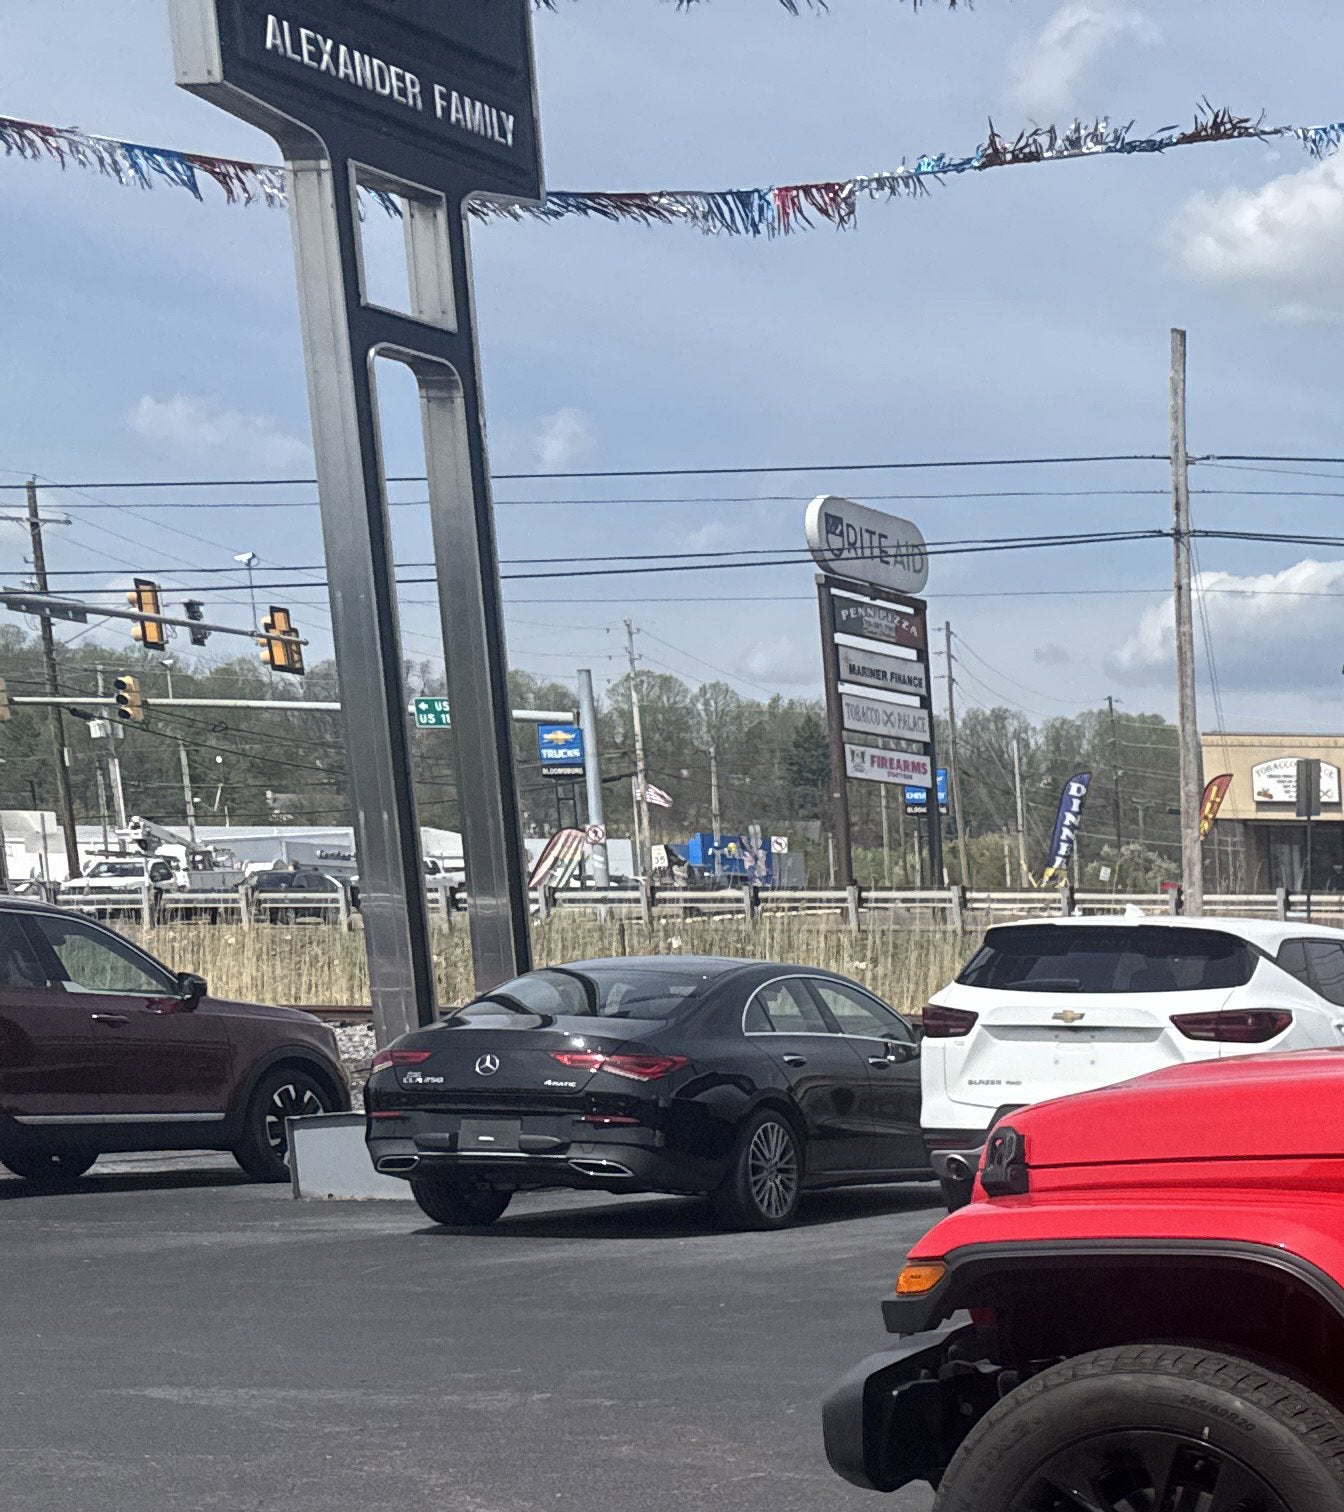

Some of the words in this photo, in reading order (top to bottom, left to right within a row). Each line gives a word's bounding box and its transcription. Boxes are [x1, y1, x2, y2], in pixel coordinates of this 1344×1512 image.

[265, 14, 422, 111] ALEXANDER
[433, 83, 514, 147] FAMILY
[846, 523, 890, 565] RITE
[894, 538, 924, 574] AID
[841, 607, 874, 620] PENN
[879, 610, 918, 637] PIZZA
[848, 663, 888, 681] MARINER
[890, 671, 923, 688] FINANCE
[434, 701, 450, 711] US
[845, 702, 880, 726] TOBACCO
[897, 712, 927, 733] PALACE
[419, 714, 435, 724] US
[541, 748, 581, 758] TRUCKS
[870, 754, 928, 775] FIREARMS
